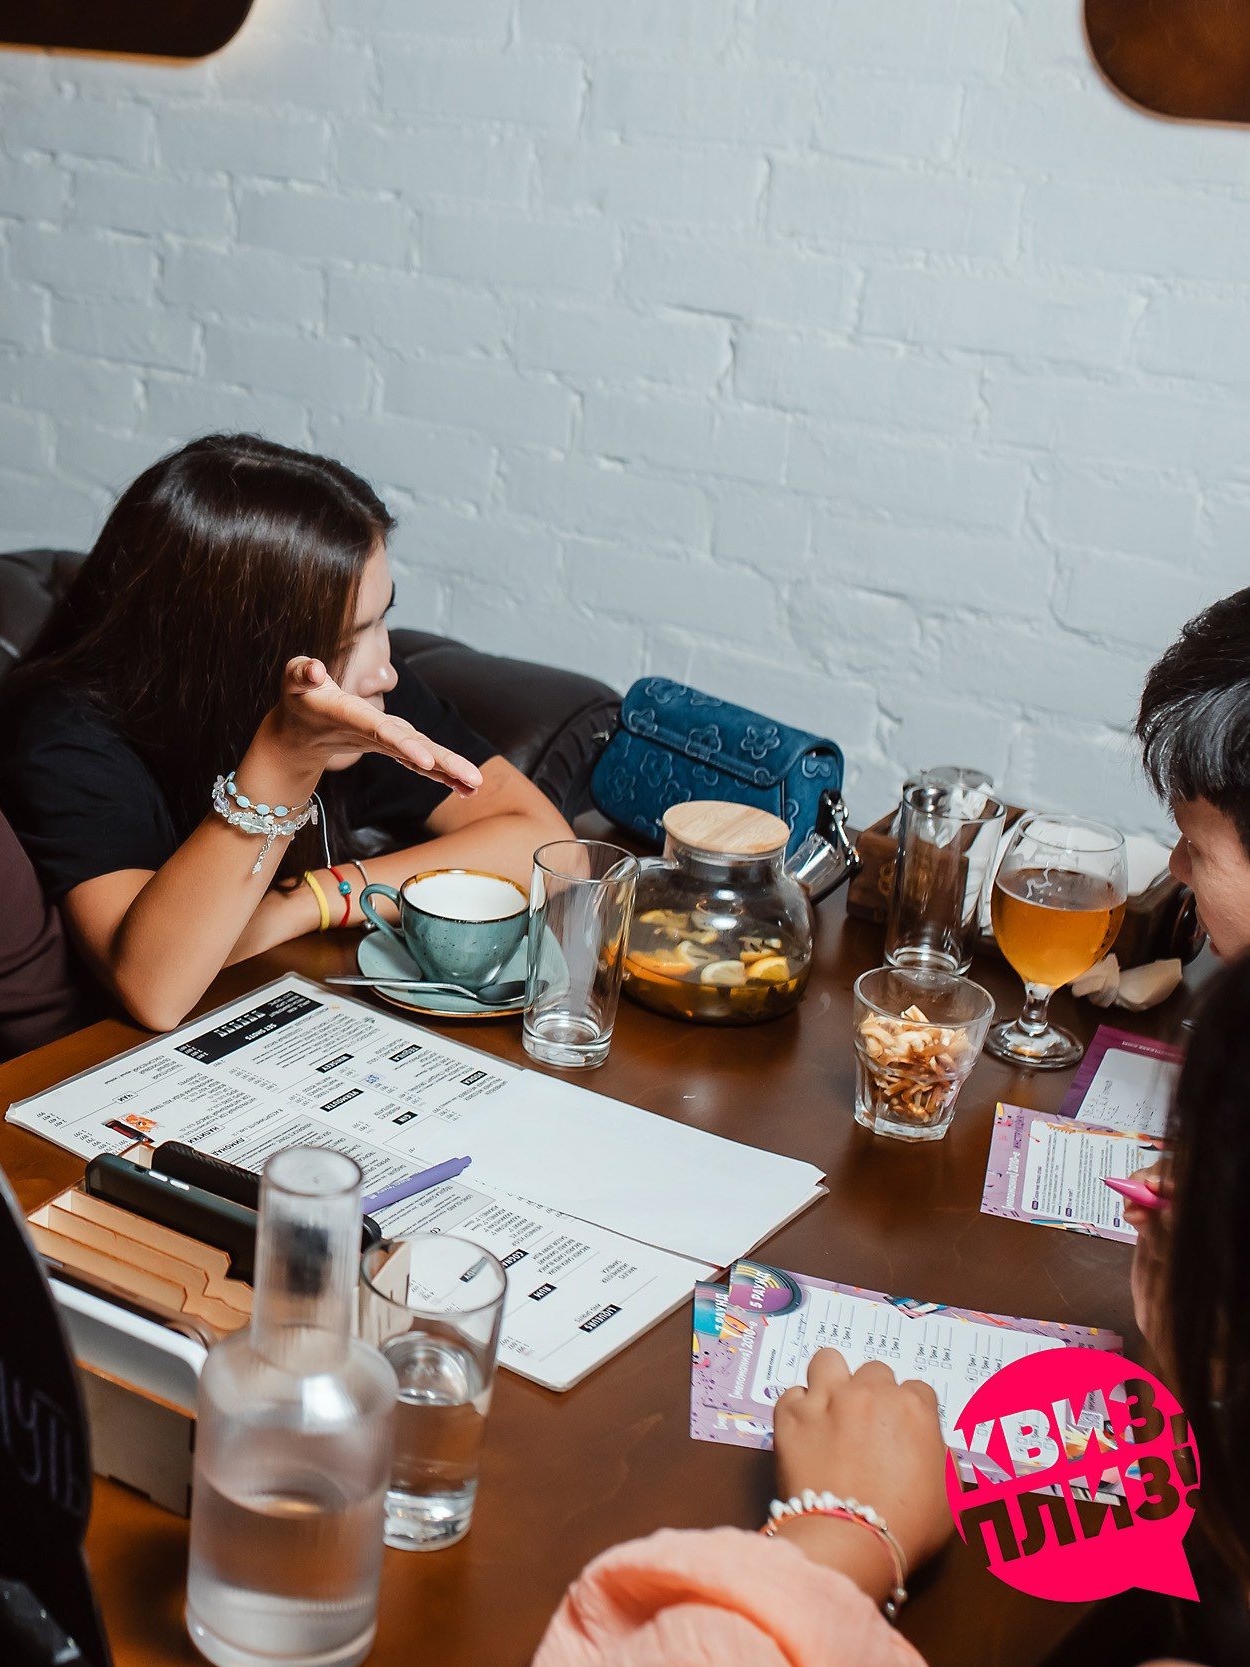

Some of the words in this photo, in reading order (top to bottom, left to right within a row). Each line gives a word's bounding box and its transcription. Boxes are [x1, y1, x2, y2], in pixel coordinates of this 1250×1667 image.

[242, 1028, 267, 1040] SHOTS
[261, 1022, 278, 1031] SET
[318, 1054, 349, 1071] WHISKEY
[390, 1045, 419, 1061] TEQUILA
[462, 1071, 484, 1084] VODKA
[322, 1089, 359, 1110] VERMOUTH
[396, 1113, 412, 1122] GIN
[186, 1125, 220, 1144] НАПИТКИ
[209, 1136, 246, 1156] ЛИМОНАД
[1006, 1150, 1021, 1172] 2010-е
[532, 1285, 551, 1297] RUM
[749, 1269, 770, 1301] РАУНД
[710, 1291, 729, 1324] РАУНД
[749, 1300, 763, 1309] 5
[582, 1306, 617, 1330] LIQUEURS
[738, 1318, 758, 1349] 2010-е
[729, 1347, 754, 1400] [меломания]
